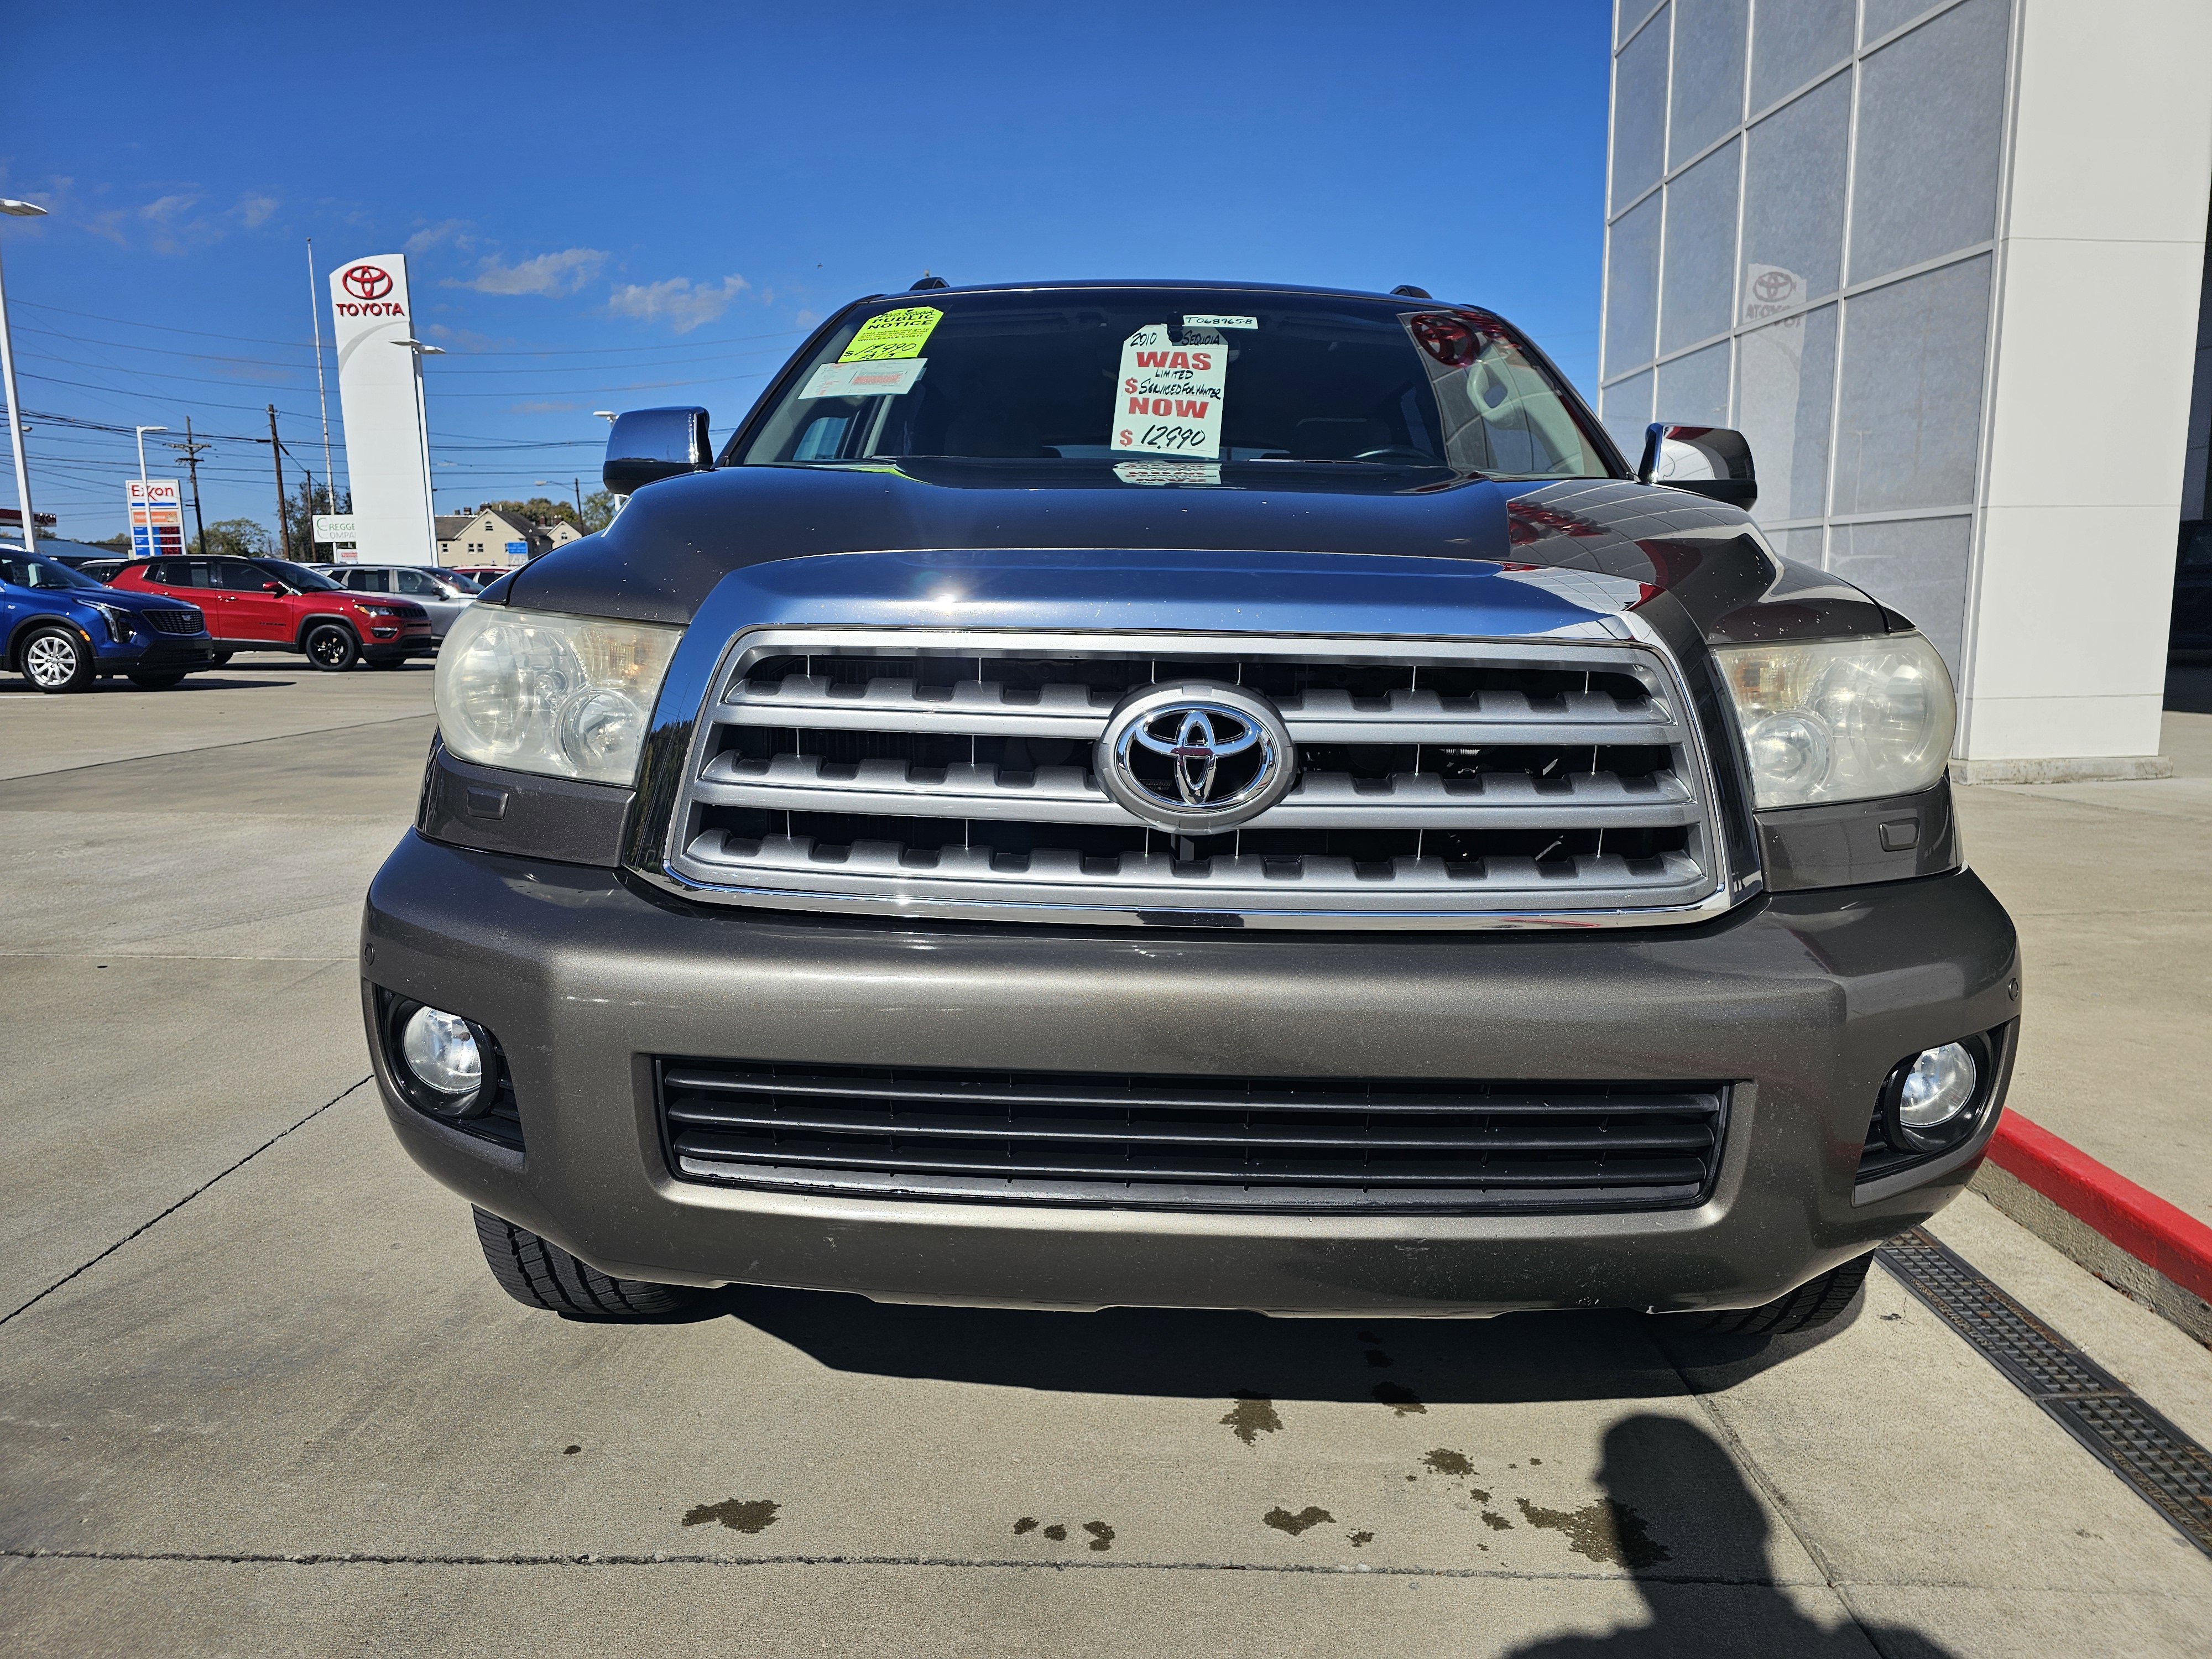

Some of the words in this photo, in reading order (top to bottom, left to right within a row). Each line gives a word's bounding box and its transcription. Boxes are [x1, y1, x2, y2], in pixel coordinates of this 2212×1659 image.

[336, 303, 405, 317] TOYOTA
[867, 320, 933, 330] NOTICE
[872, 314, 936, 324] PUBLIC
[1130, 332, 1157, 347] 2010
[1181, 330, 1220, 346] SEQUOIA
[1136, 351, 1212, 371] WAS
[1155, 367, 1193, 380] LIMITED
[1125, 377, 1138, 394] $
[1129, 397, 1209, 419] NOW
[1120, 429, 1133, 447] $
